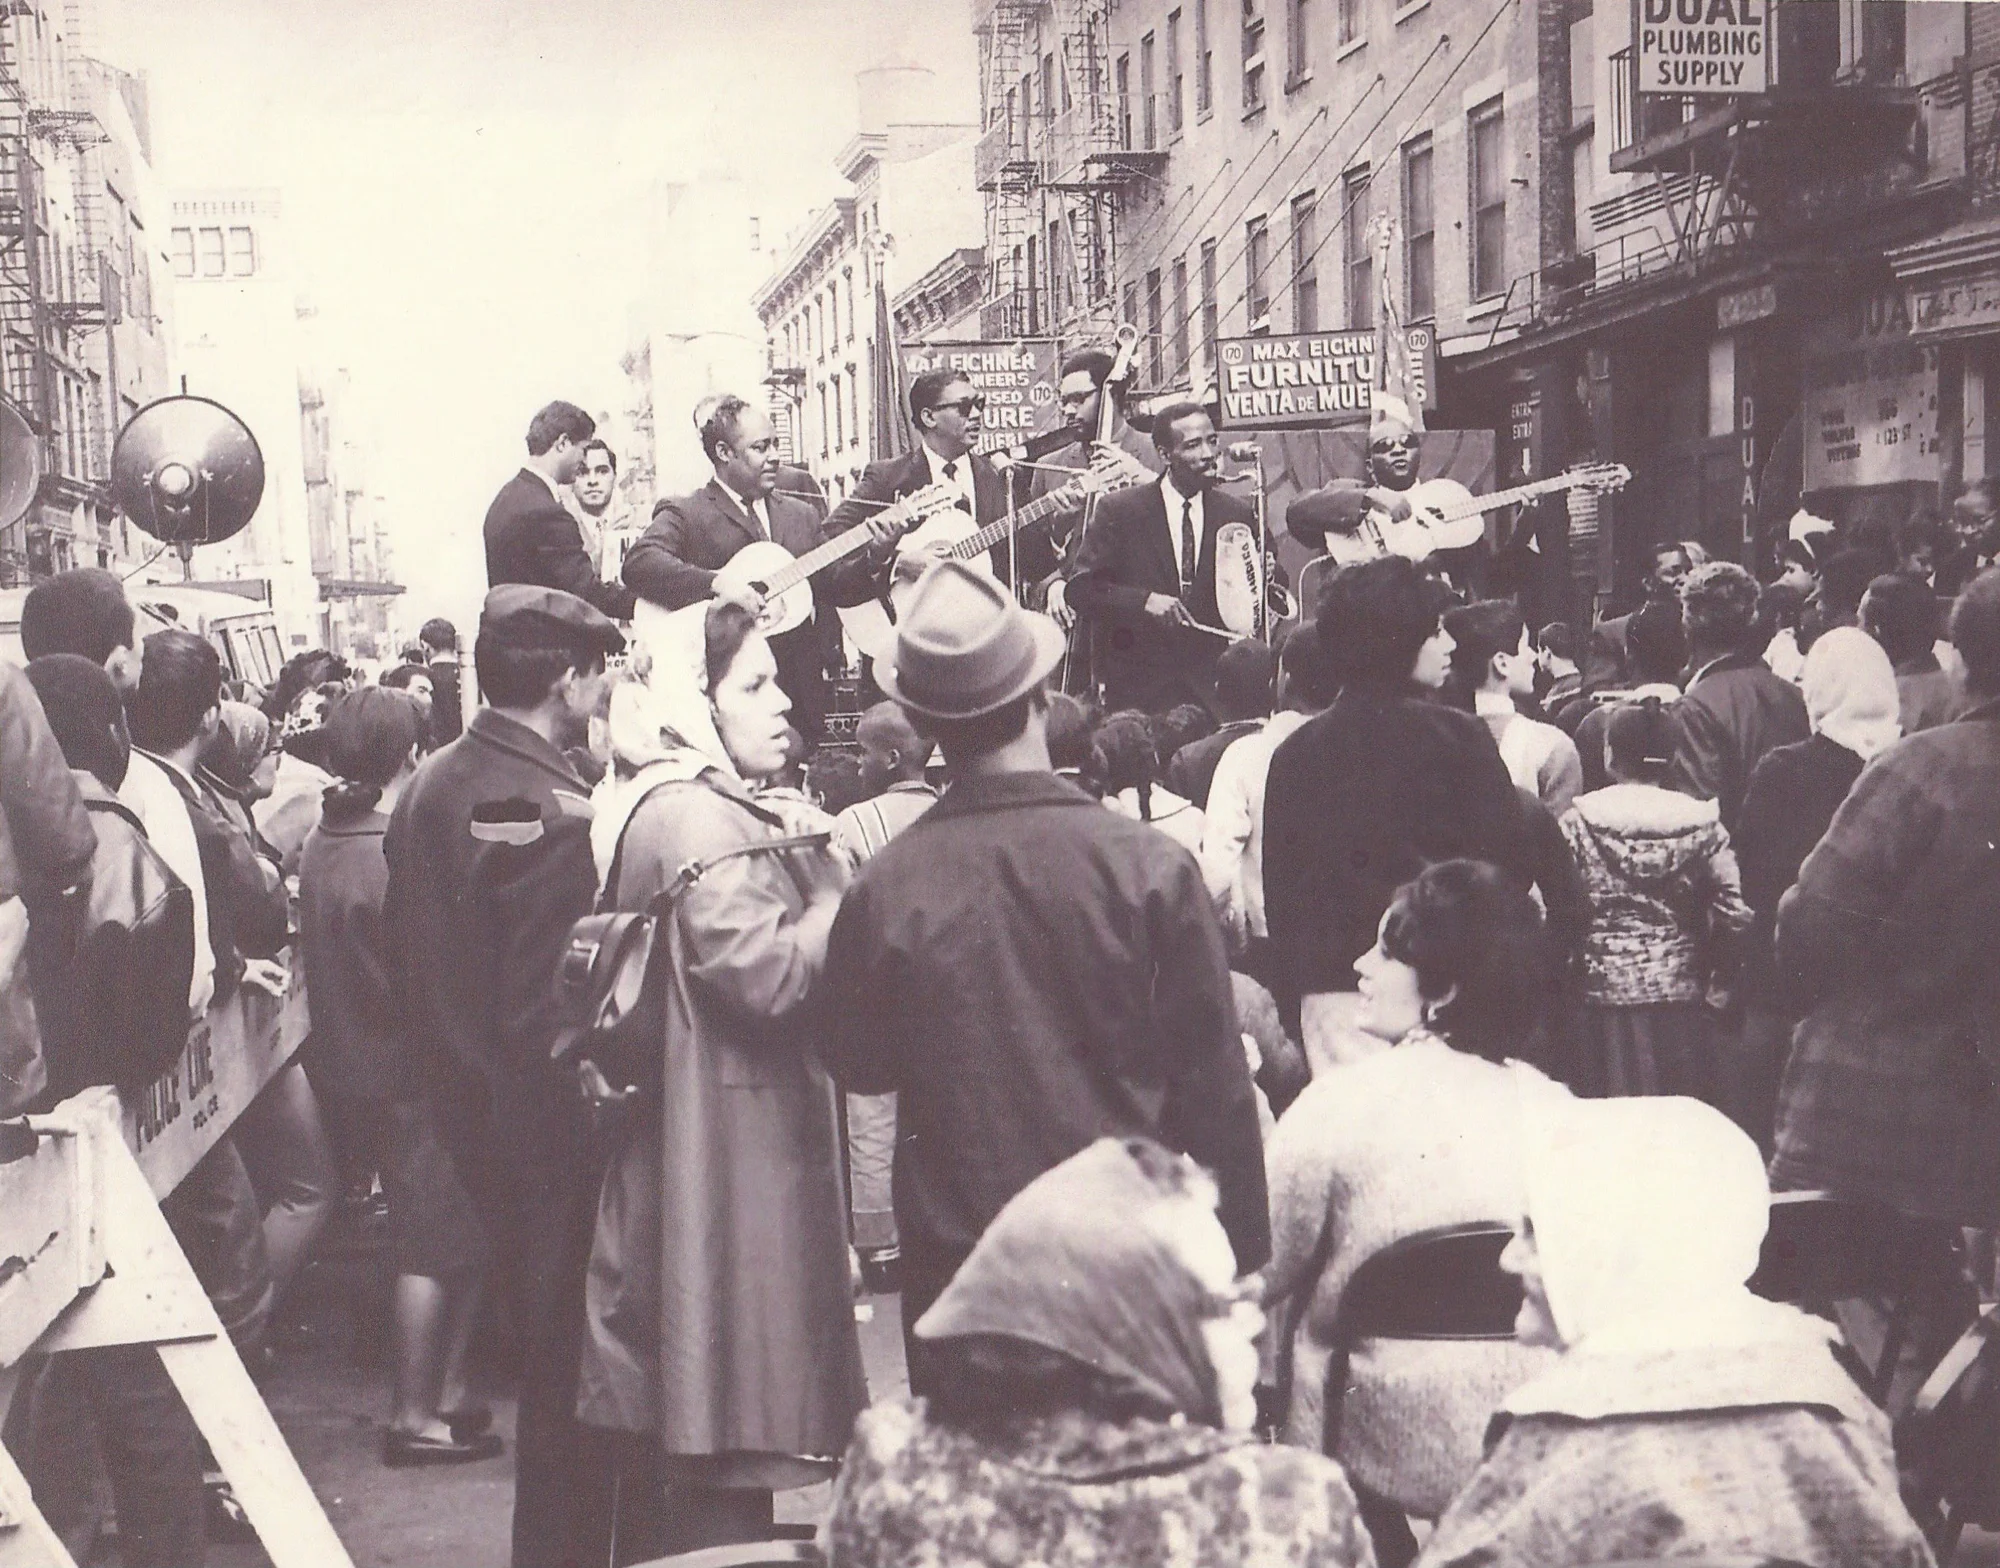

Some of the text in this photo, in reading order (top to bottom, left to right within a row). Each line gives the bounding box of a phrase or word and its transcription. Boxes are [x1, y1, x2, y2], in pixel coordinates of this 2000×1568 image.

[1645, 0, 1762, 25] DUAL
[1643, 29, 1762, 55] PLUMBING
[1658, 60, 1744, 85] SUPPLY
[1225, 335, 1376, 361] 170 MAX EICHN
[1410, 333, 1427, 347] 170
[949, 352, 1036, 371] EICHNER
[968, 370, 1029, 388] NEERS
[1033, 385, 1051, 401] 170
[1225, 388, 1296, 419] VENTA
[1297, 395, 1314, 413] DE
[983, 406, 1034, 429] URE
[1741, 396, 1755, 543] DUAL
